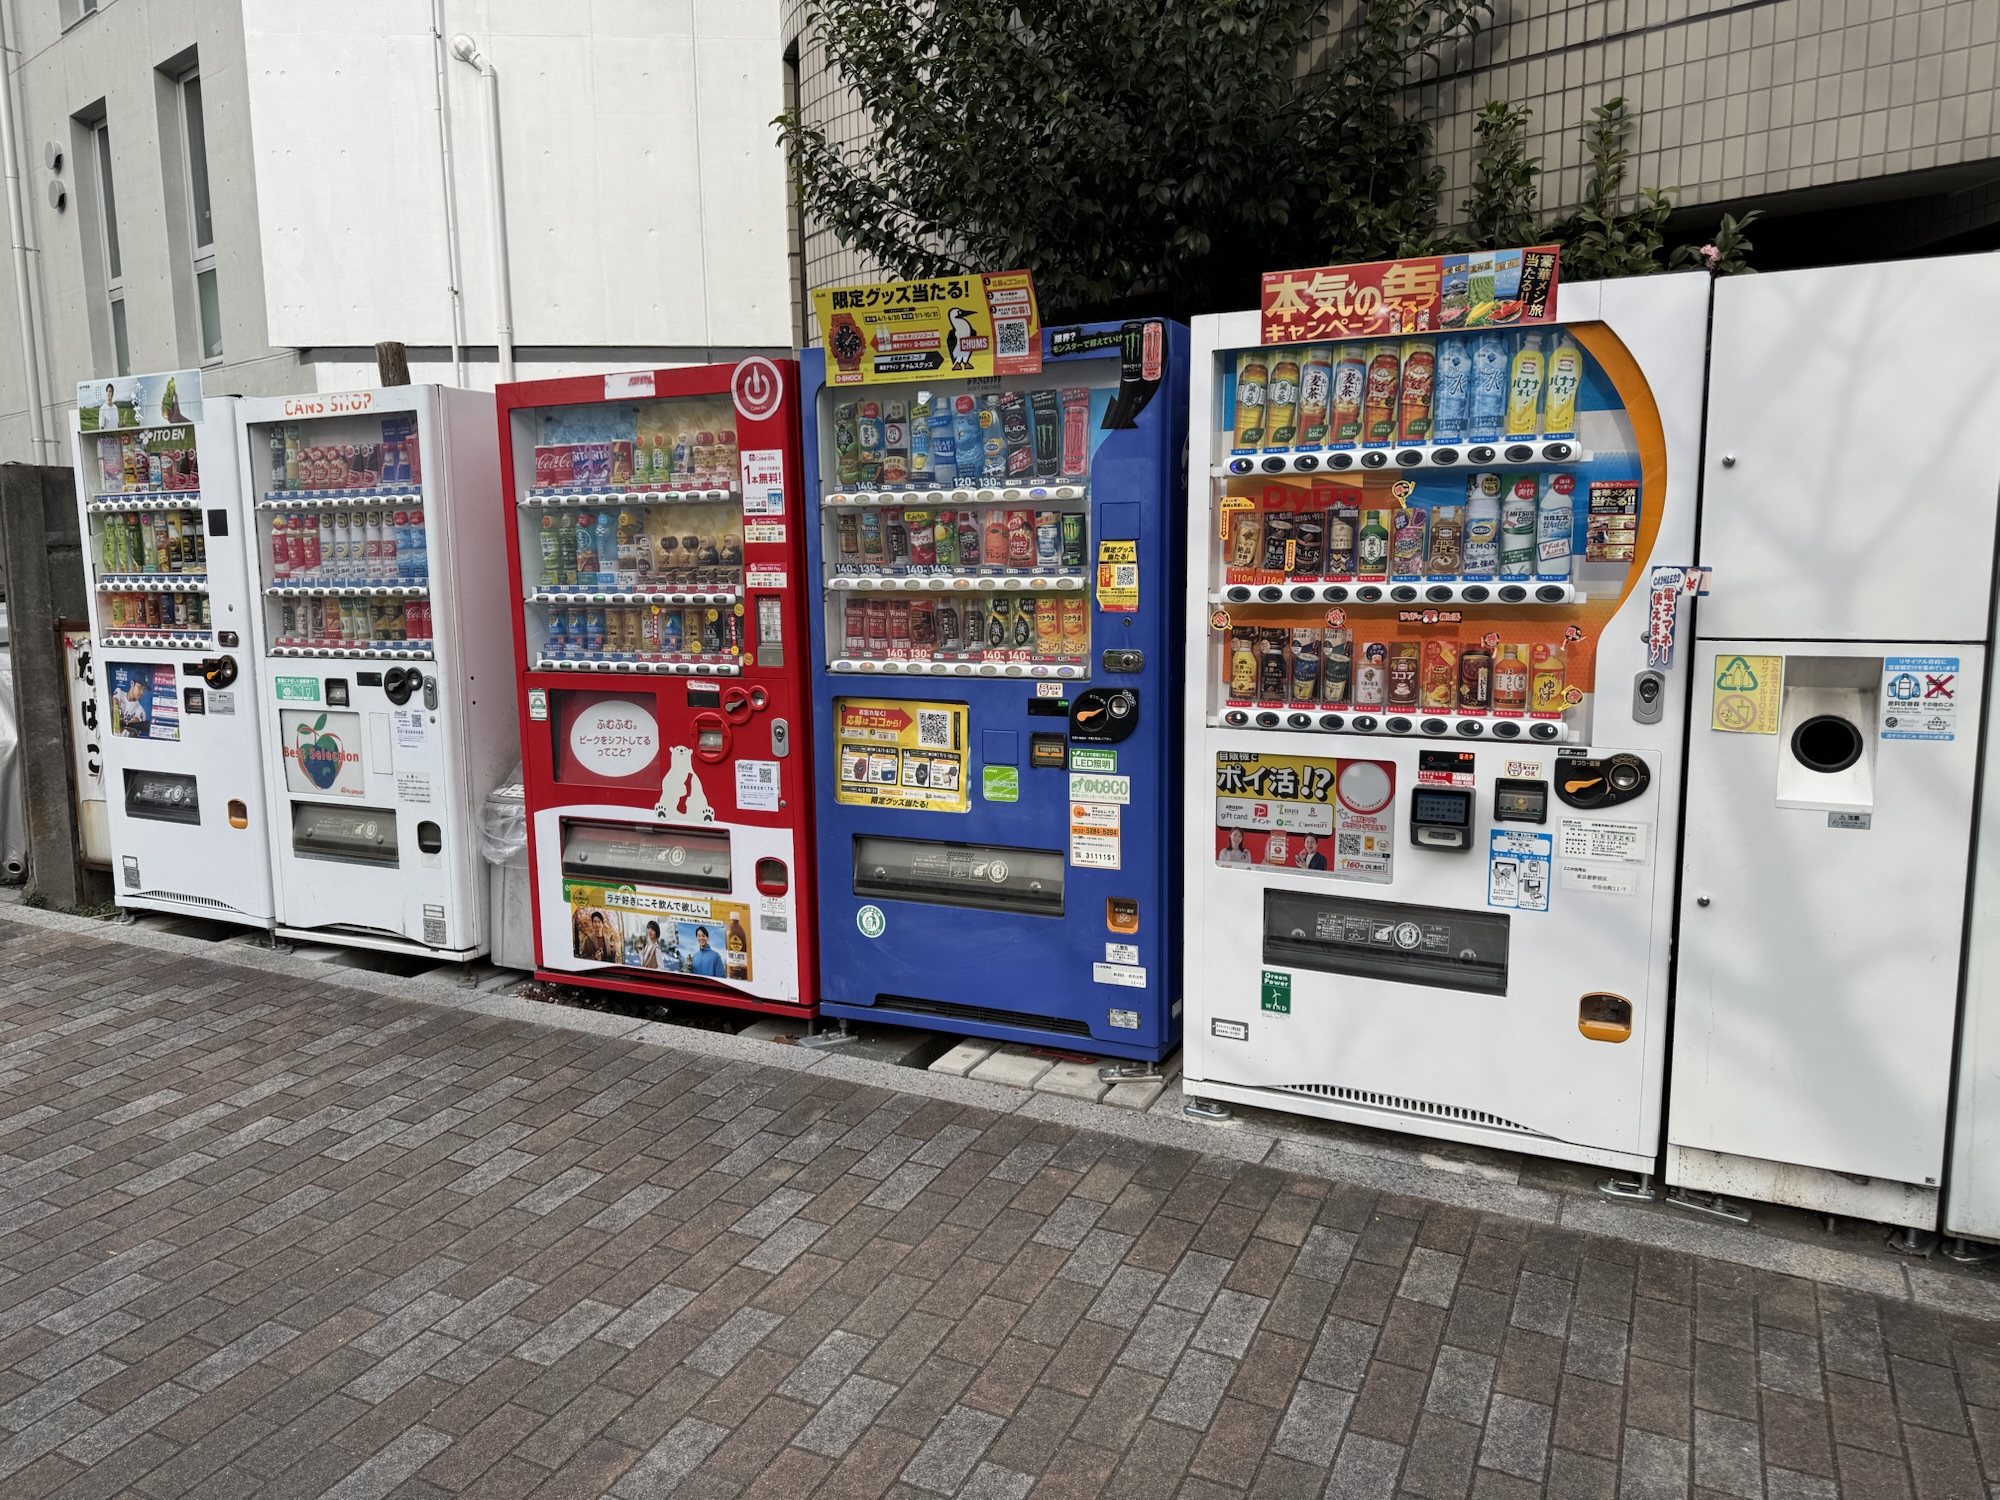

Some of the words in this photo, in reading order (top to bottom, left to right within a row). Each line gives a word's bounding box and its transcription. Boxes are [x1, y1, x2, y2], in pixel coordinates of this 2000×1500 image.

[1471, 261, 1494, 273] 北海道
[1528, 254, 1556, 318] 豪華メシ旅
[832, 280, 970, 310] 限定グッズ当たる!
[1265, 315, 1384, 342] キャンペーン
[961, 337, 988, 350] CHUMS
[1053, 335, 1123, 353] モンスターで超えていけ
[900, 362, 934, 370] チャムスグッズ
[1342, 372, 1356, 398] 麦茶
[1512, 379, 1540, 389] バナナ
[1549, 375, 1577, 386] バナナ
[1308, 374, 1323, 400] 麦茶
[153, 429, 171, 442] ITO
[171, 428, 186, 440] EN
[1004, 425, 1026, 433] BLACK
[744, 464, 782, 485] 1本無料!
[1517, 488, 1534, 497] 爽快
[1592, 488, 1636, 496] 豪華メシ旅
[1262, 483, 1364, 514] DyDo
[1233, 575, 1254, 584] 110円
[1653, 574, 1681, 586] CASHLESS
[1650, 592, 1663, 664] 使えます!
[1661, 588, 1674, 662] 電子マネー
[886, 648, 907, 658] 140円
[910, 649, 931, 658] 130円
[983, 650, 1005, 660] 140円
[1008, 650, 1031, 660] 140円
[1391, 672, 1415, 680] ココア
[1505, 668, 1514, 698] ほうじ茶
[1544, 680, 1555, 701] ゆず
[1758, 659, 1769, 731] リサイクルBOXです
[1768, 659, 1780, 732] ごみ箱ではありません
[597, 719, 637, 730] ふむふむ。
[846, 715, 902, 727] 応募はココから!
[579, 736, 651, 746] ピークをシフトしてる
[283, 746, 306, 759] Best
[309, 747, 360, 762] Selection
[597, 747, 632, 757] ってこと?
[1075, 758, 1111, 769] LED照明
[1216, 763, 1334, 800] ポイ活!?
[870, 796, 929, 809] 限定グッズ当たる!
[1221, 812, 1232, 820] gift
[1233, 812, 1248, 820] card
[1577, 874, 1608, 882] 東京都新宿区
[606, 894, 709, 915] ラテ好きにこそ飲んで欲しい。
[1264, 972, 1288, 981] Green
[1264, 978, 1289, 987] Power
[1265, 1003, 1288, 1012] WIND
